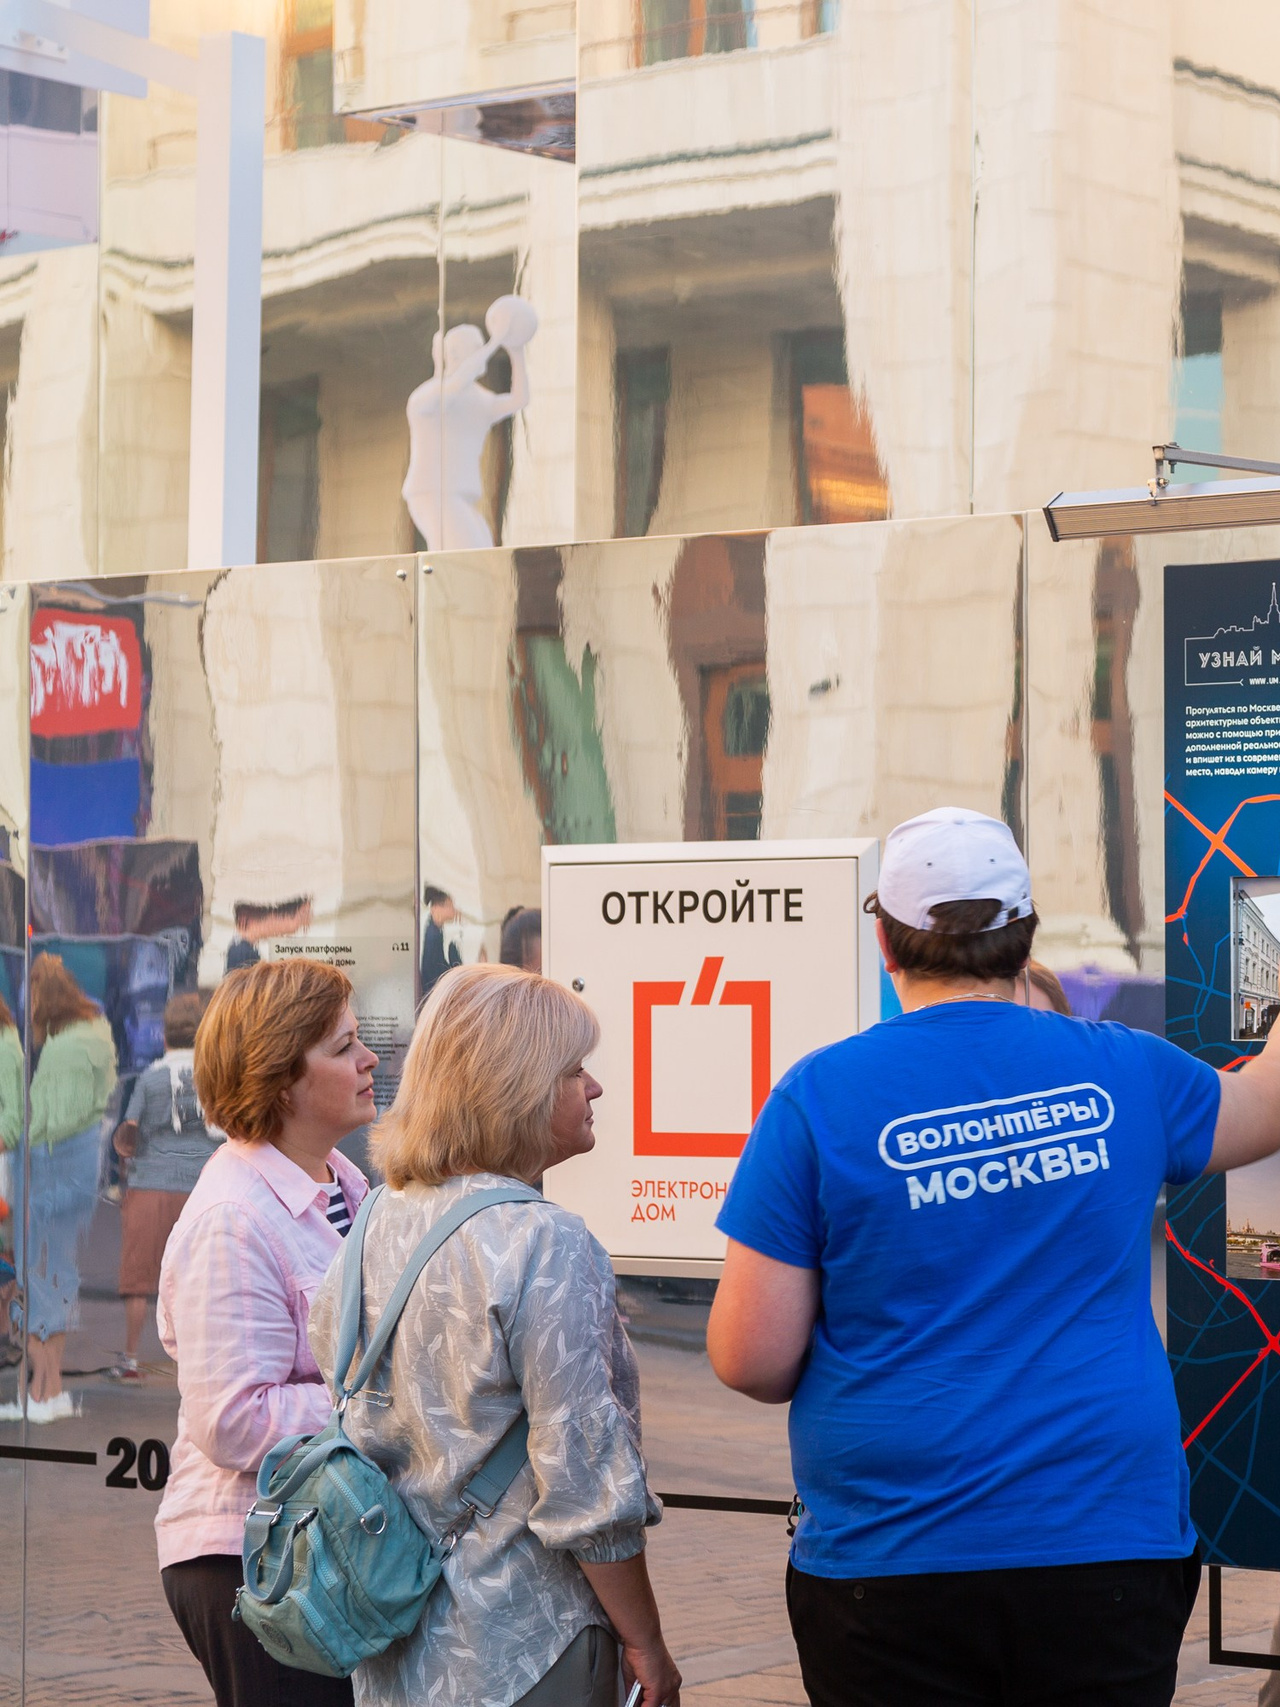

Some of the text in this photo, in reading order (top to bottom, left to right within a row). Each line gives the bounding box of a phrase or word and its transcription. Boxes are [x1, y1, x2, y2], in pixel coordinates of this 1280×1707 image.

[1199, 646, 1262, 668] УЗНАЙ
[1186, 706, 1235, 716] Прогуляться
[1250, 704, 1280, 712] Москве
[1186, 717, 1248, 728] архитектурные
[1222, 729, 1263, 738] помощью
[1186, 741, 1241, 752] дополненной
[1193, 756, 1223, 764] впишет
[1186, 767, 1213, 776] место,
[1214, 766, 1245, 776] наводи
[1247, 766, 1278, 775] камеру
[602, 880, 804, 925] ОТКРОЙТЕ
[275, 945, 351, 954] Запуск платформы
[400, 942, 409, 951] 11
[906, 1138, 1111, 1210] МОСКВЫ
[632, 1180, 727, 1199] ЭЛЕКТРОН
[631, 1203, 675, 1222] ДОМ
